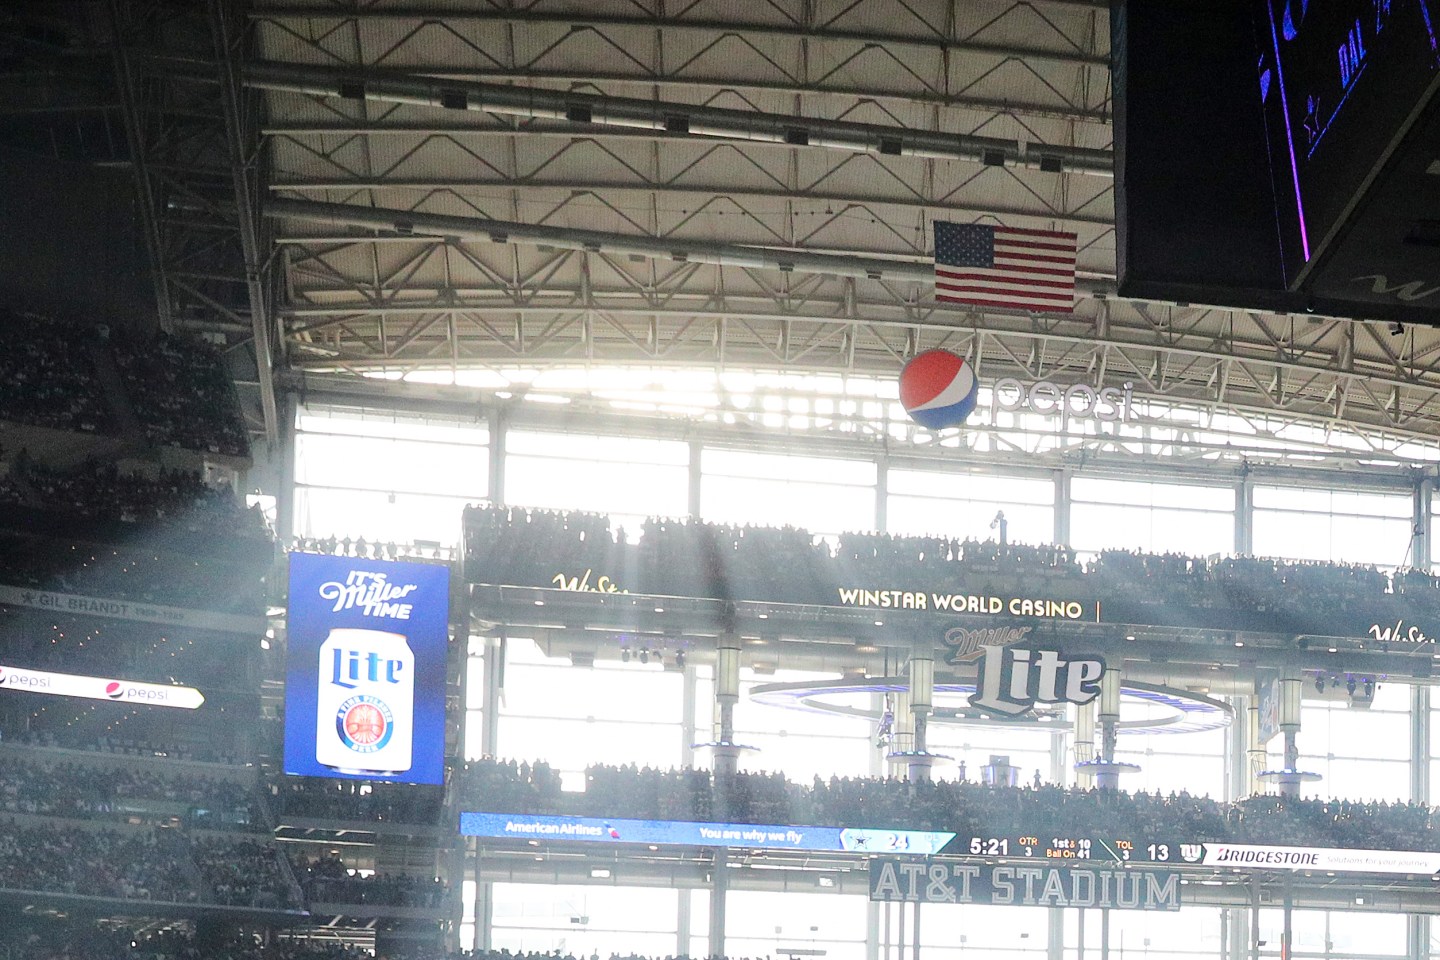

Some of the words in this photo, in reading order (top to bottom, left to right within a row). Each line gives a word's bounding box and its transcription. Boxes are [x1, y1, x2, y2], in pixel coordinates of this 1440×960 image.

[1339, 19, 1366, 89] DAL
[991, 377, 1134, 432] pepsi
[346, 570, 387, 586] IT'S
[319, 581, 417, 612] Miller
[838, 588, 926, 610] WINSTAR
[932, 593, 1003, 613] WORLD
[1009, 598, 1083, 618] CASINO
[38, 595, 62, 608] GIL
[68, 598, 130, 616] BRANDT
[363, 602, 413, 619] TIME
[945, 626, 1032, 657] Miller
[330, 648, 403, 689] Lite
[9, 673, 51, 688] pepsi
[974, 644, 1102, 714] Lite
[127, 686, 168, 700] pepsi
[505, 820, 559, 835] American
[560, 823, 603, 837] Airlines
[699, 826, 721, 839] You
[722, 830, 741, 840] are
[742, 829, 766, 844] why
[767, 832, 786, 842] we
[786, 830, 803, 845] fly
[887, 833, 908, 850] 24
[970, 837, 1009, 855] 5:21
[1078, 839, 1091, 850] 10
[1116, 840, 1133, 850] TOL
[1025, 846, 1032, 857] 3
[1046, 849, 1062, 859] Ball
[1063, 849, 1075, 859] On
[1077, 849, 1091, 860] 41
[1123, 850, 1130, 861] 3
[1147, 844, 1169, 861] 13
[1217, 848, 1320, 865] BRIDGESTONE
[872, 862, 980, 904] AT&T
[991, 867, 1181, 911] STADIUM
